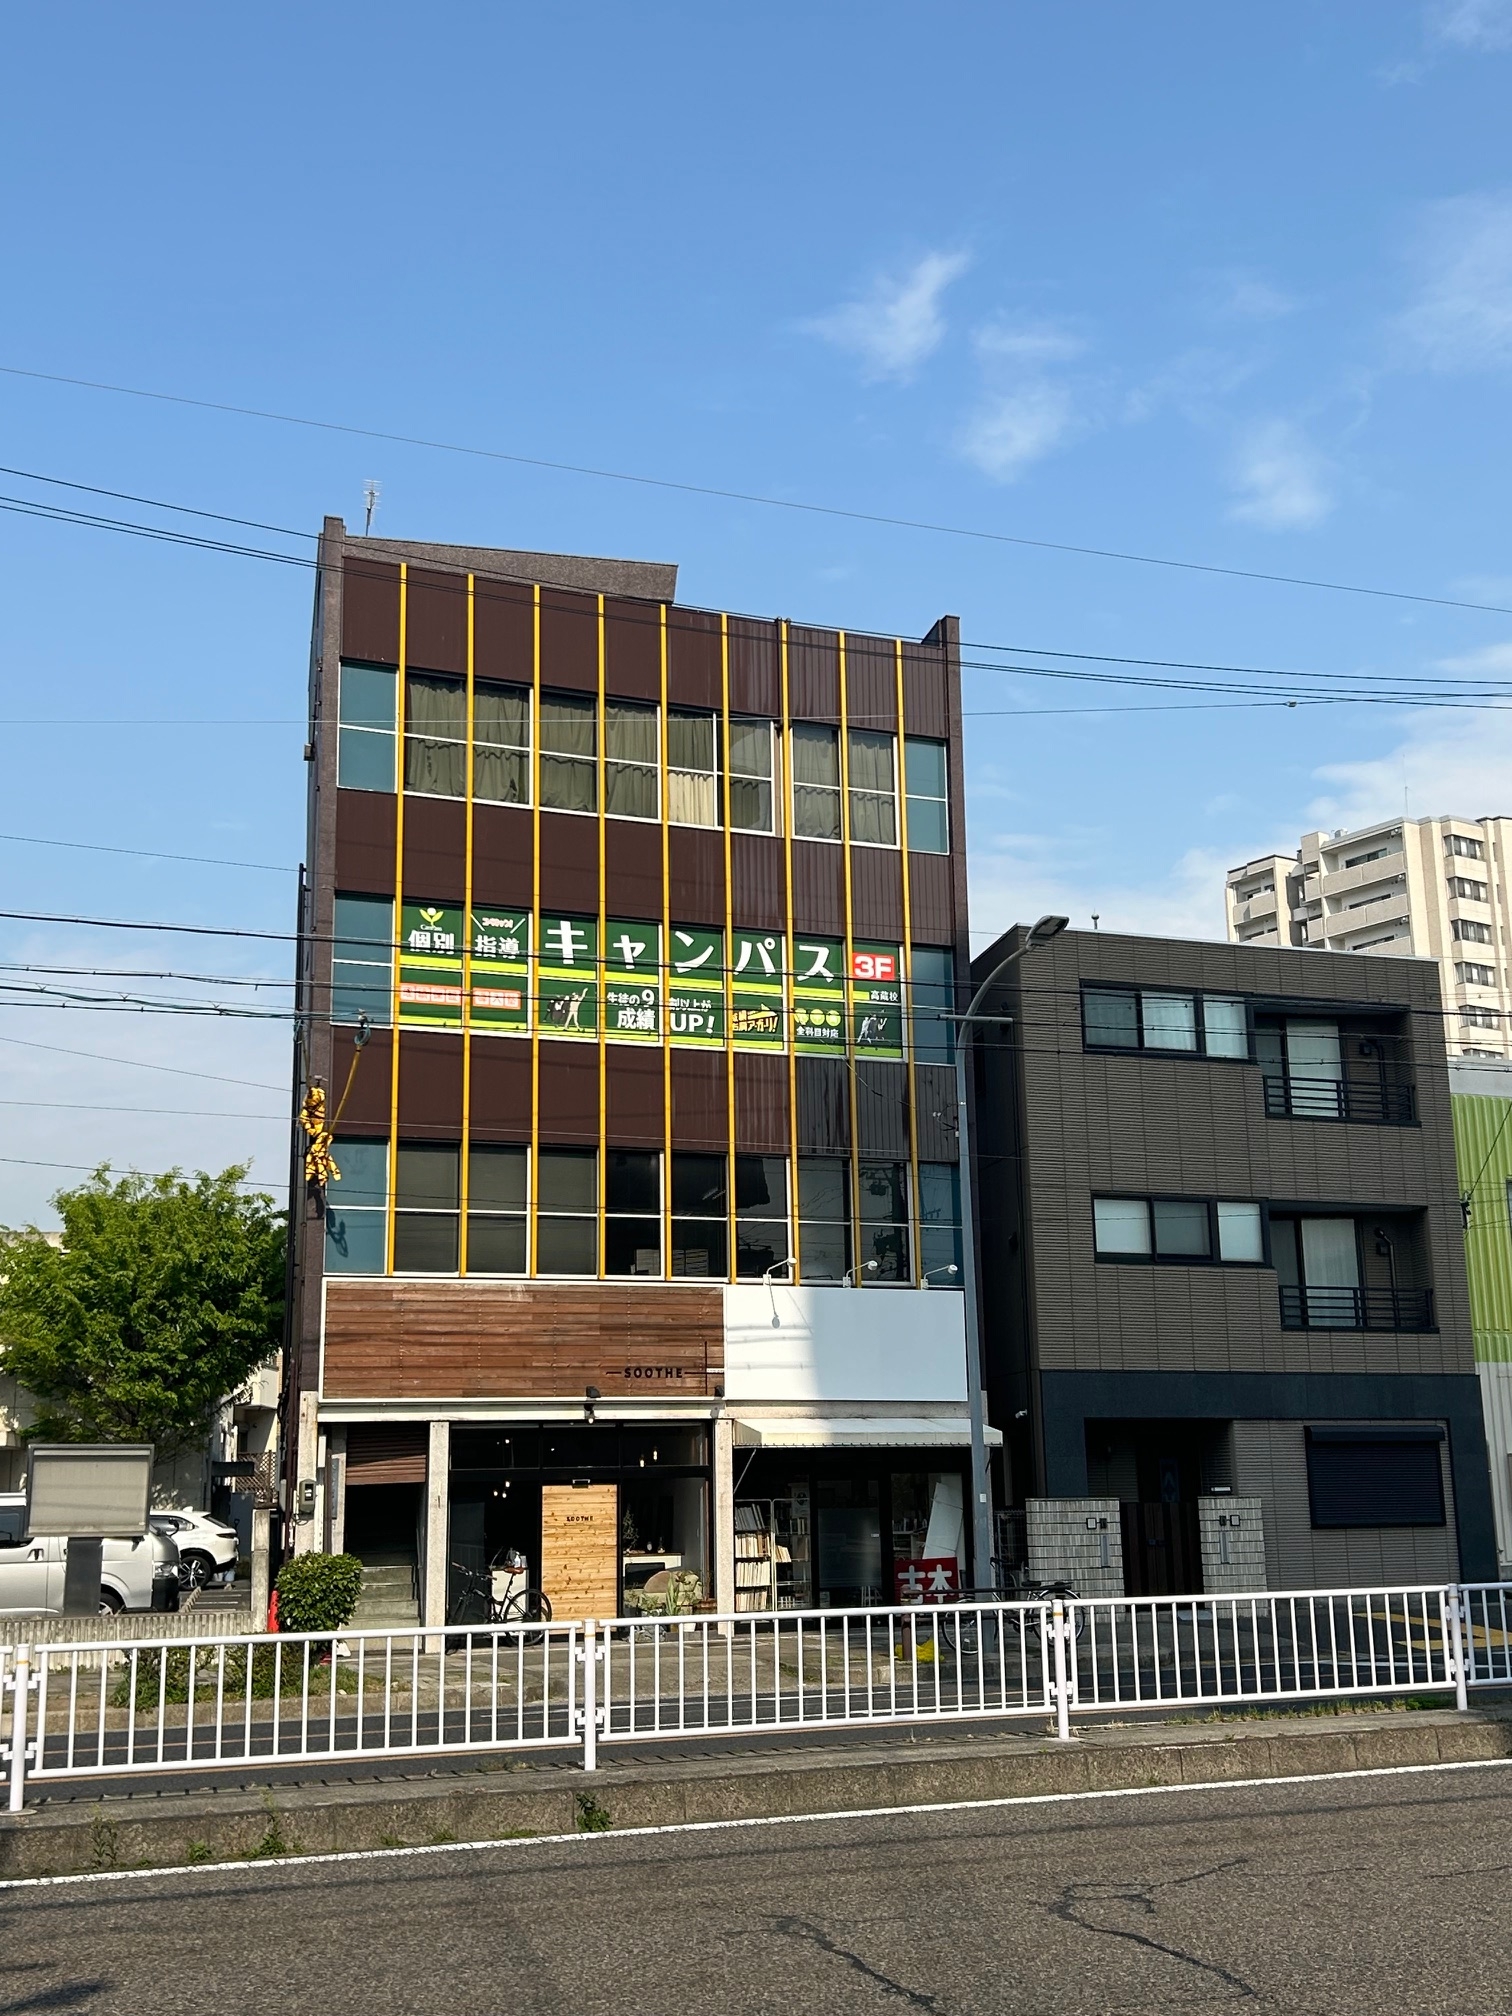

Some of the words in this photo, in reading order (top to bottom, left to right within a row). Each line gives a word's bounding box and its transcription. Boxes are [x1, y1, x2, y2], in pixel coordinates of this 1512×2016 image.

[408, 929, 520, 959] 個別指導
[545, 920, 835, 983] キャンパス
[855, 955, 892, 979] 3F
[796, 1025, 839, 1039] 全科目対応
[624, 1367, 683, 1379] SOOTHE
[897, 1564, 955, 1605] 古本
